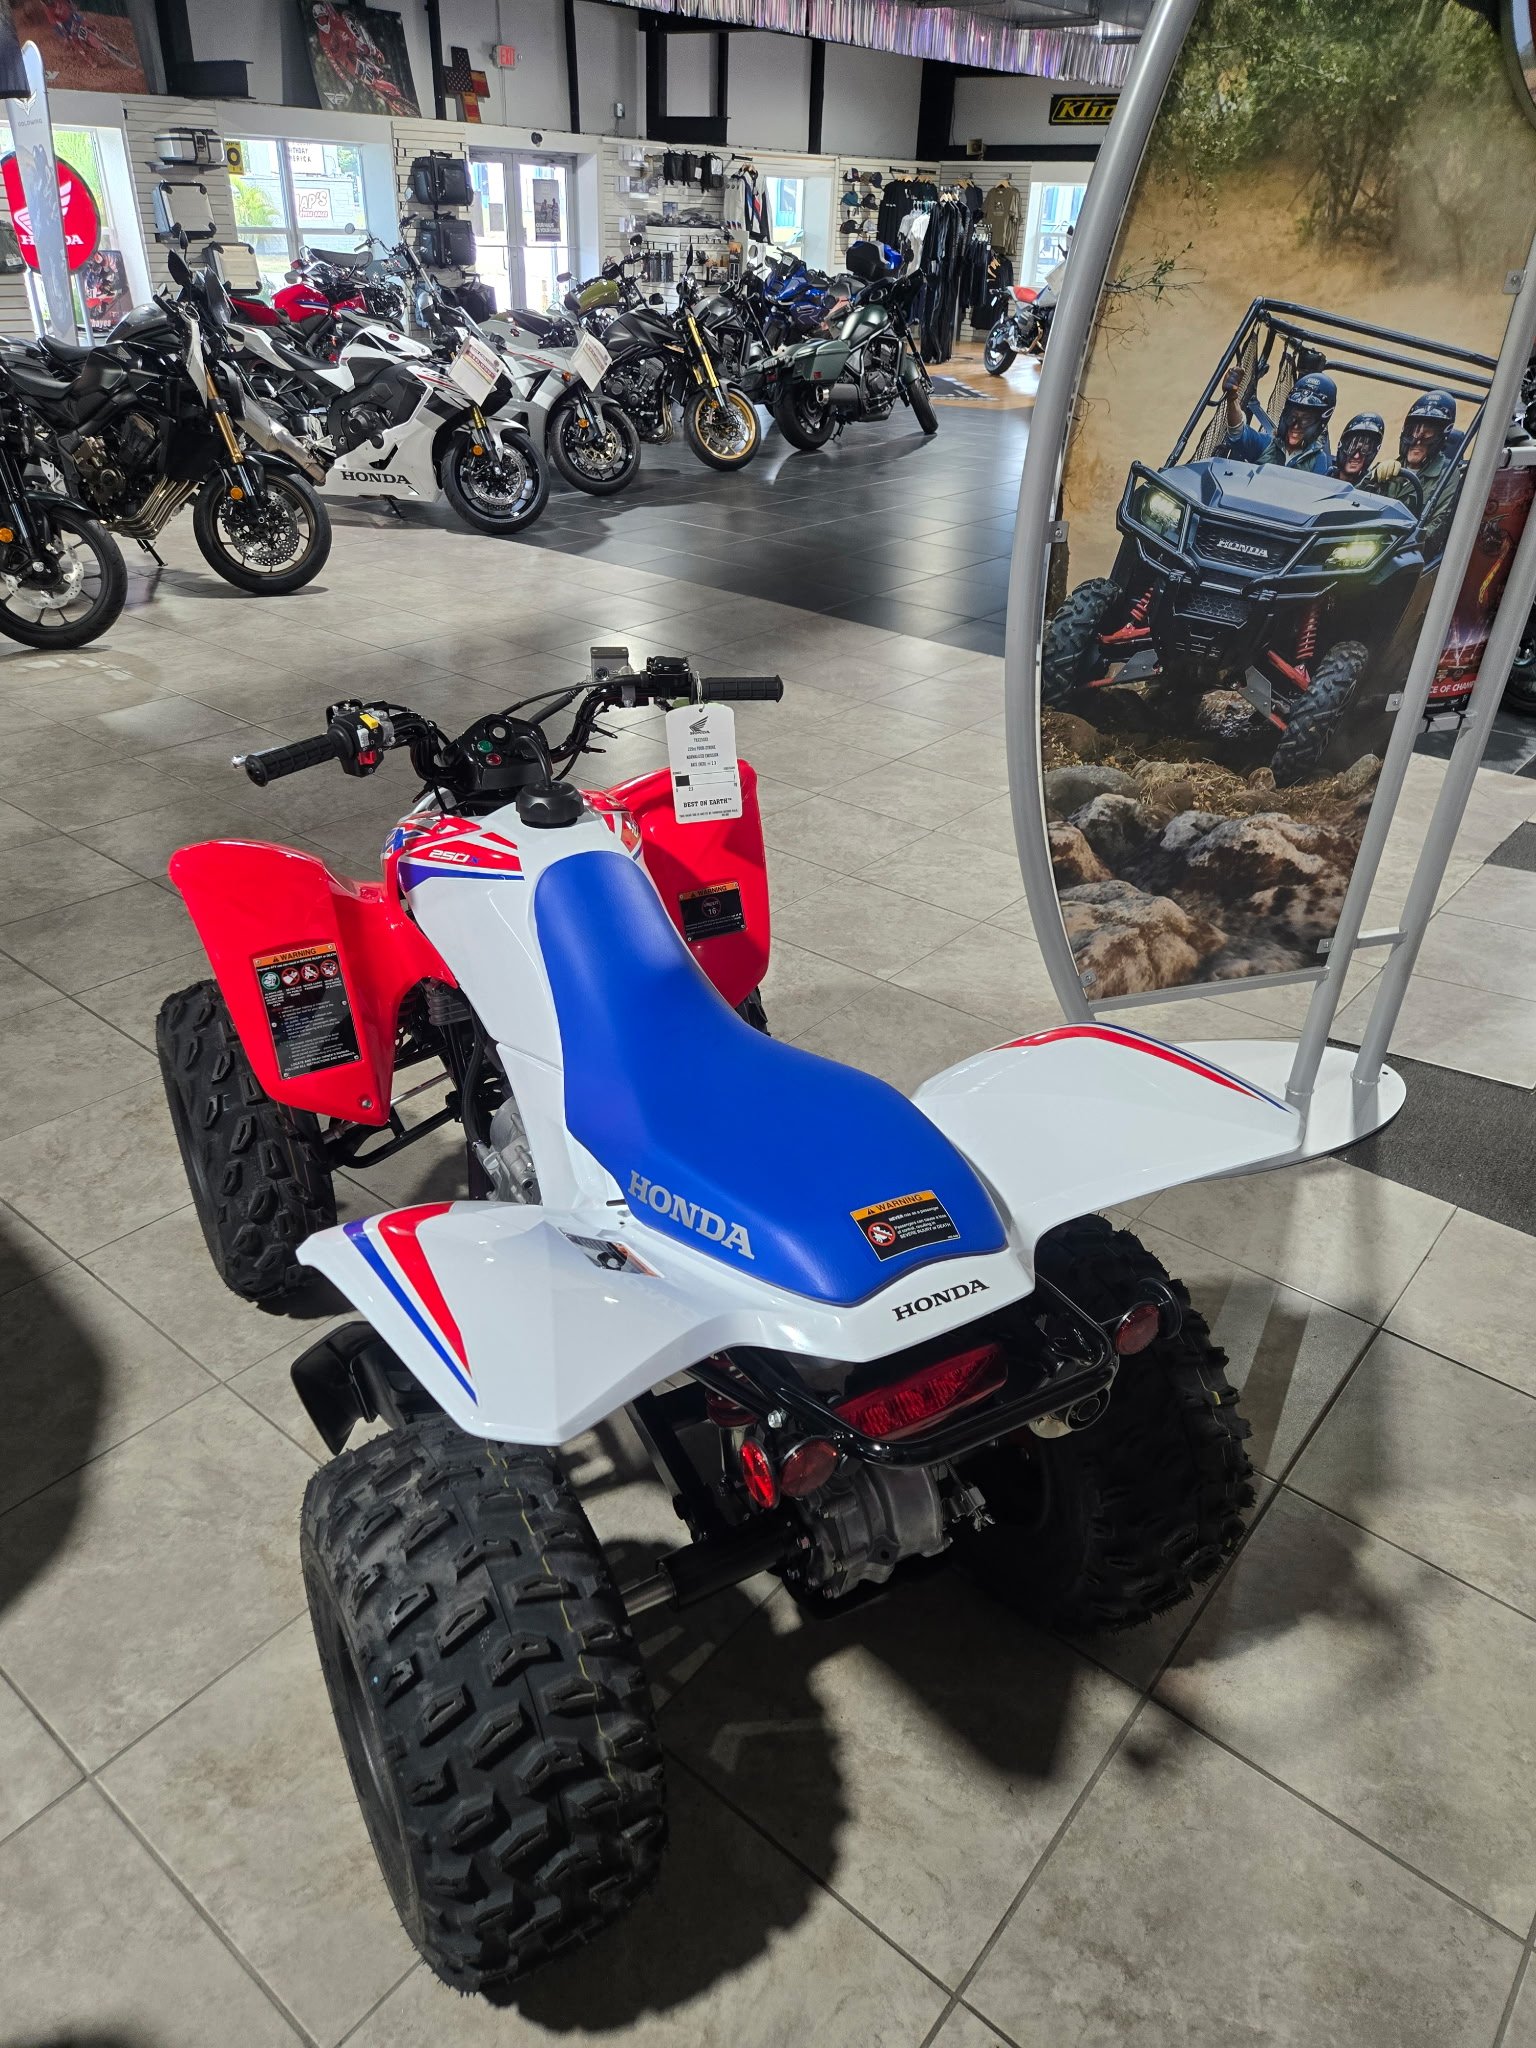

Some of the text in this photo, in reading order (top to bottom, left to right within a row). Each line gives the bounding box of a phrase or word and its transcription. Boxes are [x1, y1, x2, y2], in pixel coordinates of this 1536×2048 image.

[296, 191, 328, 210] AP'S
[340, 471, 412, 485] HONDA
[1217, 539, 1269, 558] HONDA
[1440, 684, 1451, 693] OF
[697, 885, 727, 896] WARNING
[708, 907, 717, 915] 16
[280, 948, 317, 961] WARNING
[876, 1194, 922, 1211] WARNING
[628, 1169, 756, 1261] HONDA
[892, 1279, 990, 1321] HONDA
